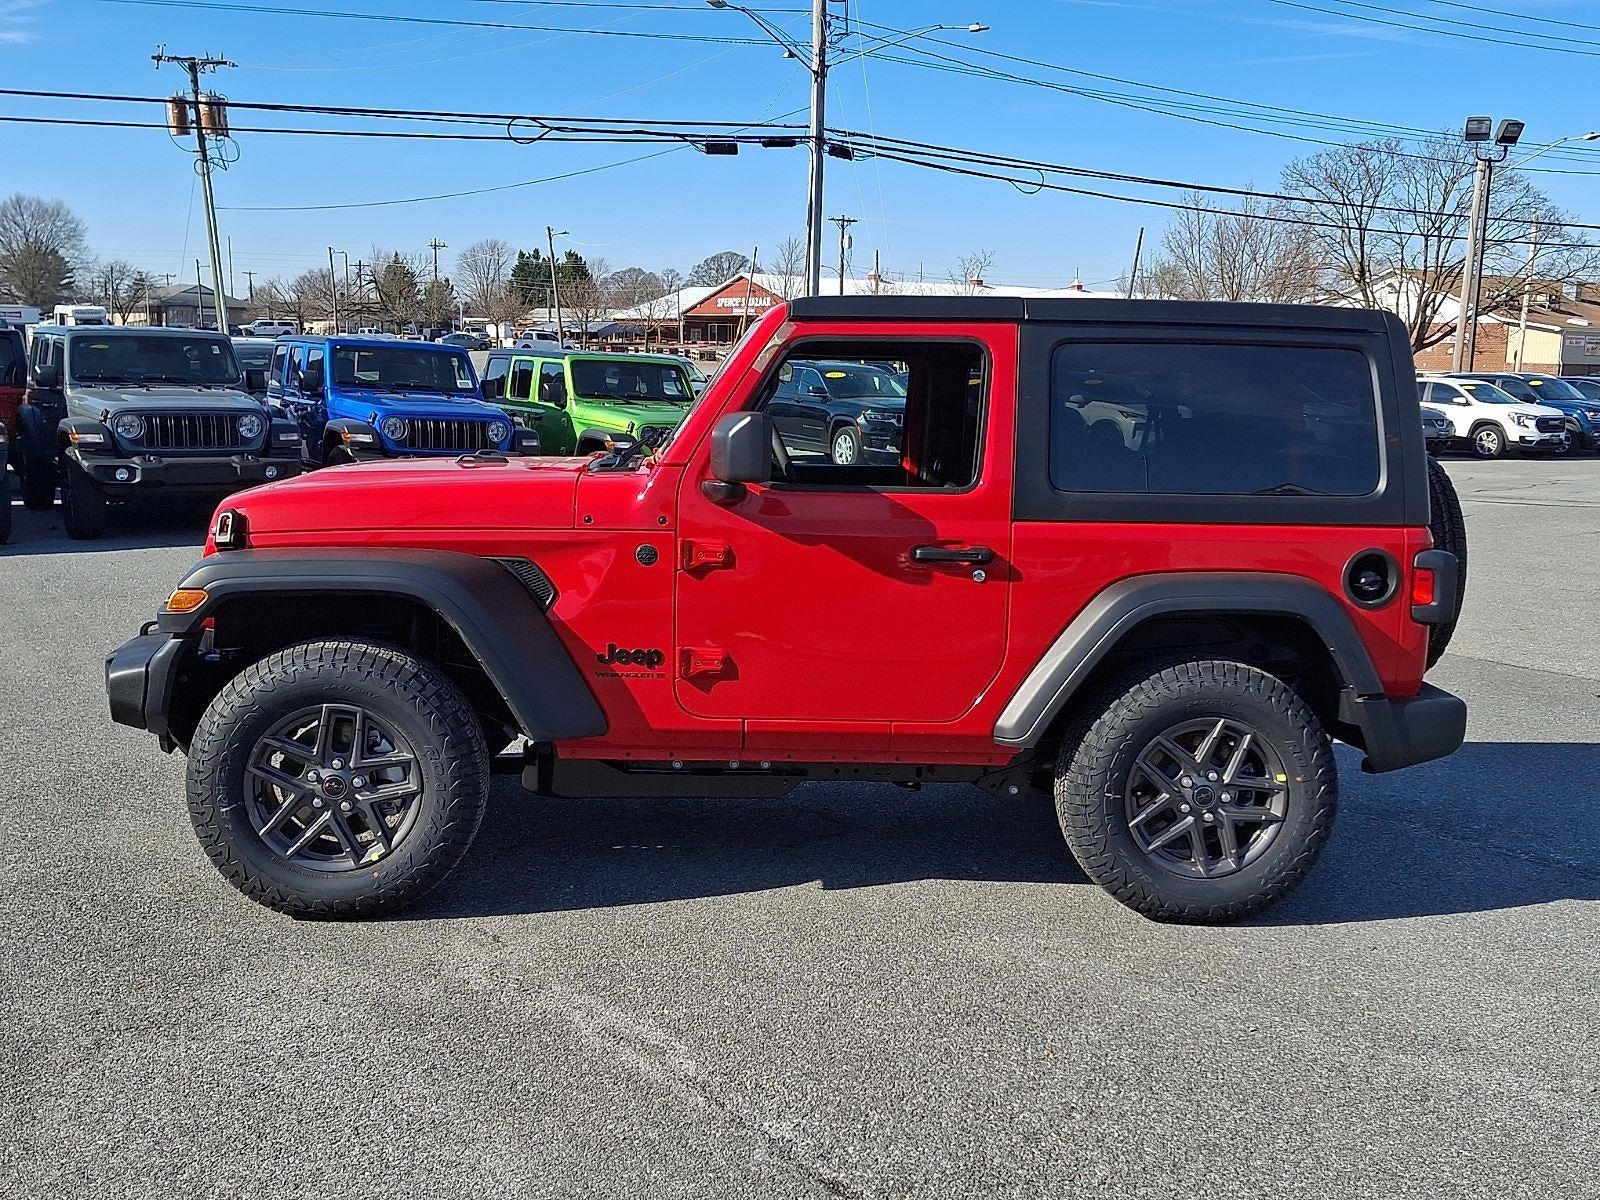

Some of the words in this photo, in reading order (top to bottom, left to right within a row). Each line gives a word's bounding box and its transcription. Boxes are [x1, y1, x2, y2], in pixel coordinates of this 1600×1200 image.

[716, 297, 745, 308] SPENCE'S
[596, 642, 665, 670] Jeep
[596, 671, 655, 679] WRANGLER
